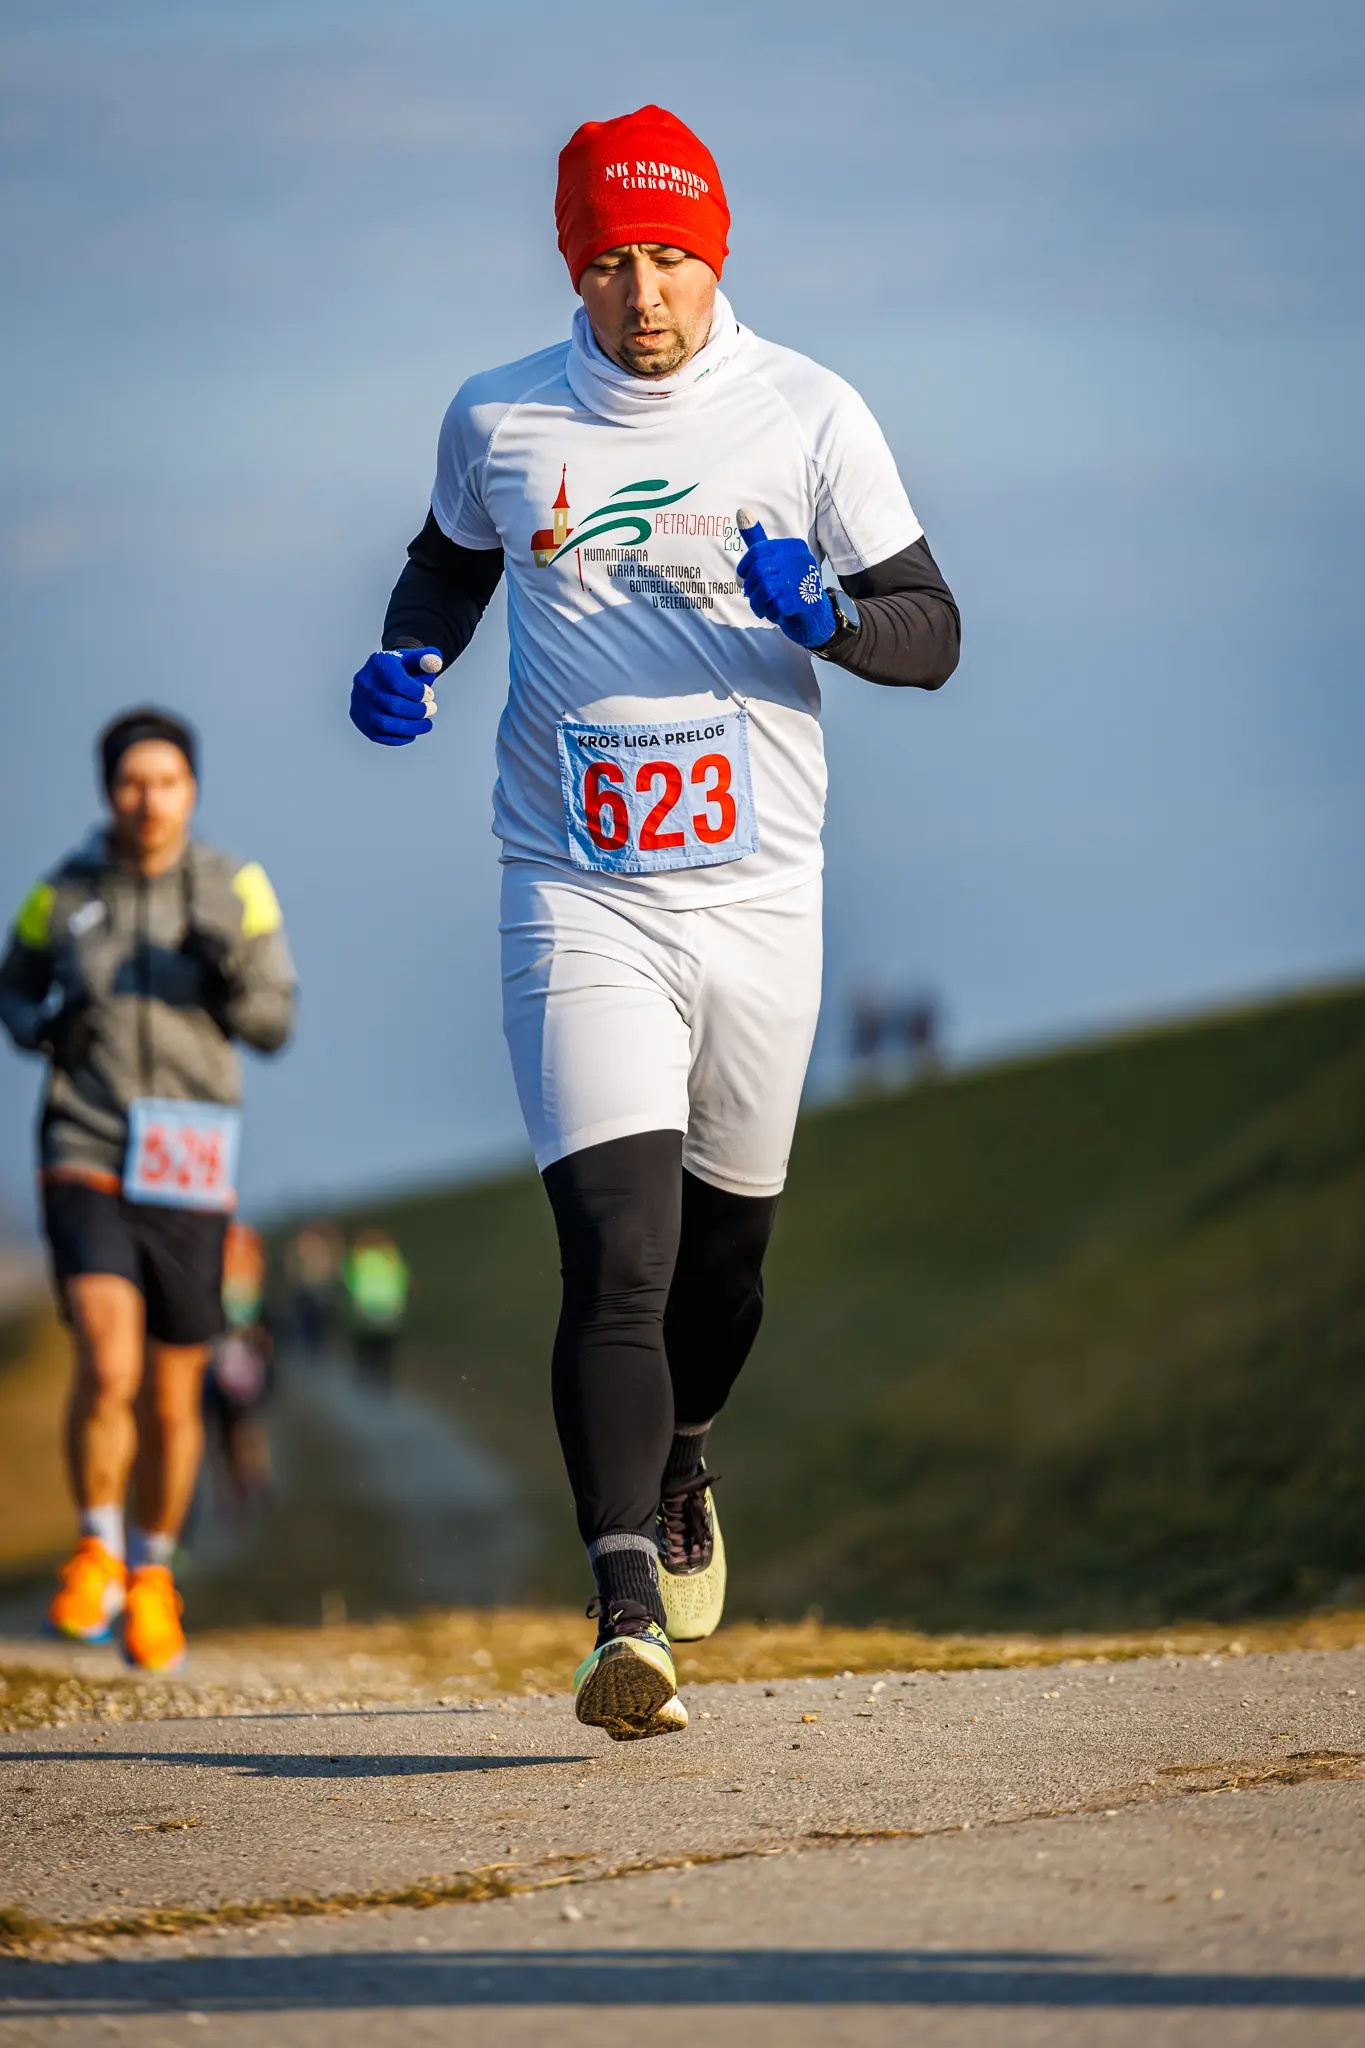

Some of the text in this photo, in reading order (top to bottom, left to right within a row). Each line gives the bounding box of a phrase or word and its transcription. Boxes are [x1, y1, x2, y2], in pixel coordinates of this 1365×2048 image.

[605, 160, 709, 194] NK NAPRIJED
[622, 177, 699, 201] CIRKOVLJAN
[584, 548, 649, 562] HUMANITARNA
[606, 564, 701, 579] UTRKA REKREATIVACA
[629, 579, 706, 595] BOMBELLESOVOM
[652, 595, 659, 609] U
[577, 724, 726, 748] KROS LIGA PRELOG
[583, 753, 737, 851] 623
